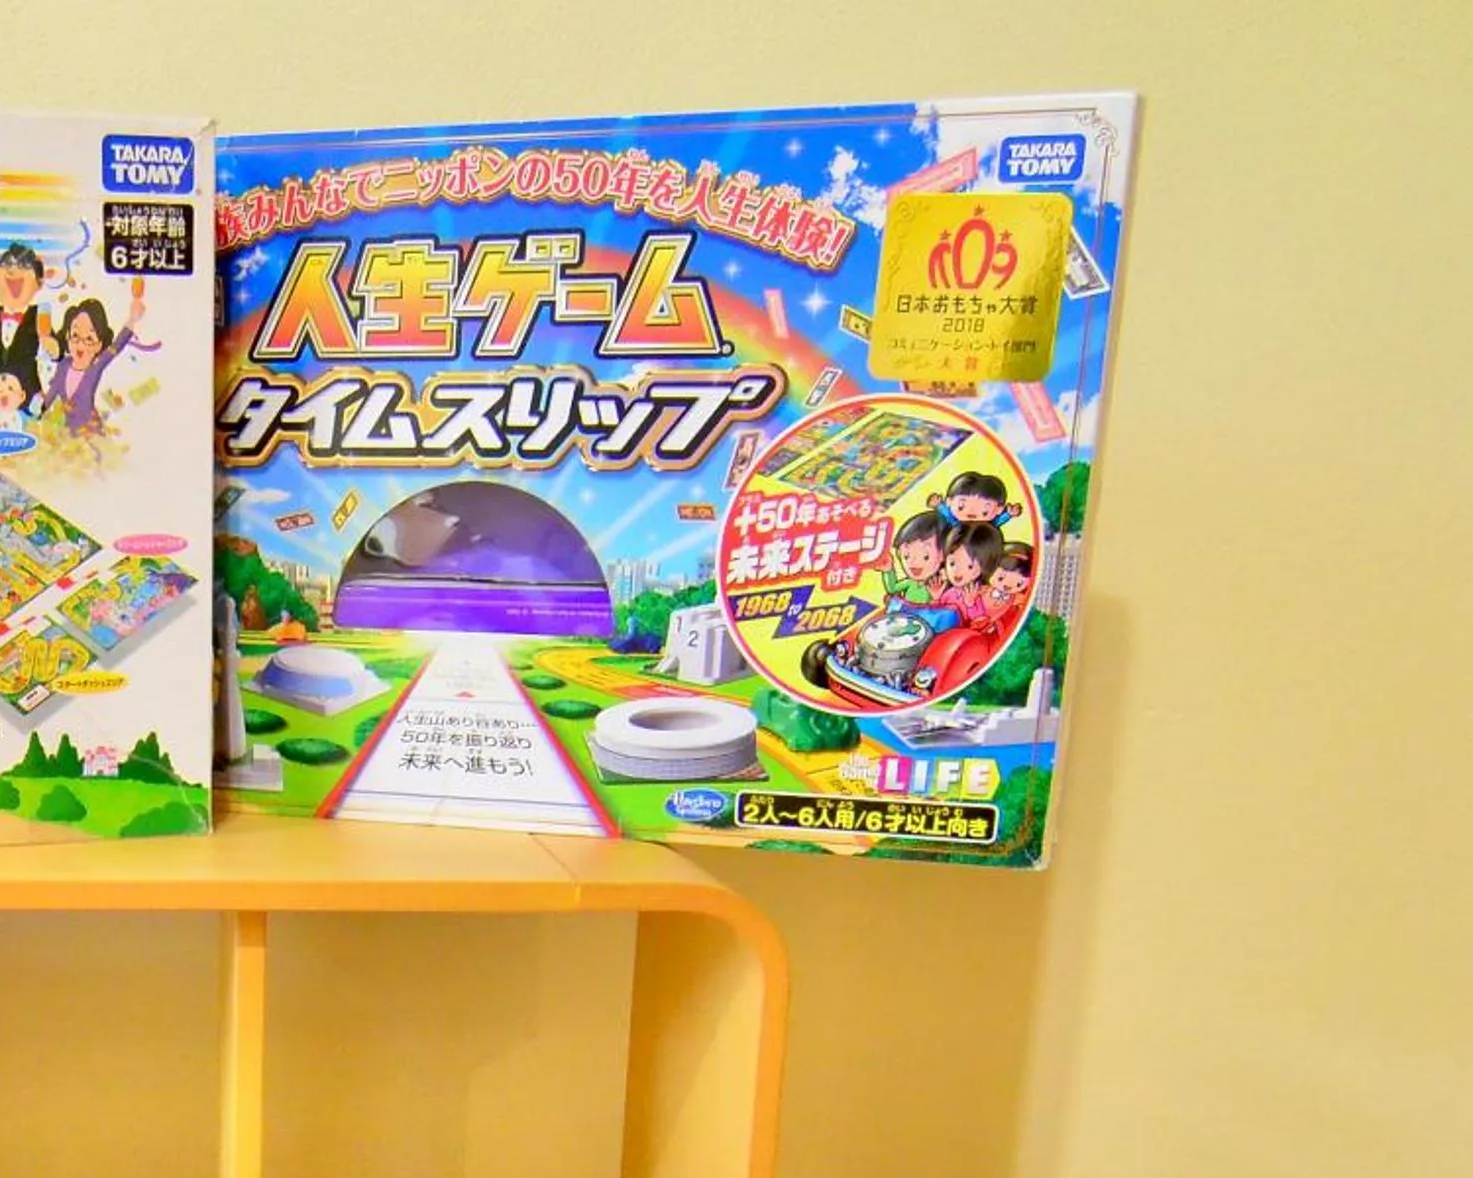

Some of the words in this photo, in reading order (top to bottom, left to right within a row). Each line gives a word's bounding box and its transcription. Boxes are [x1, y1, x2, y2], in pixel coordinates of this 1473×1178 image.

[110, 143, 185, 164] TAKARA
[1008, 141, 1077, 157] TAKARA
[110, 163, 186, 186] TOMY
[1006, 157, 1077, 177] TOMY
[108, 215, 187, 238] 対象年齢
[110, 246, 187, 270] 6才以上
[253, 232, 727, 360] 人生ゲーム
[895, 293, 1038, 316] 日本おもちゃ大賞
[941, 317, 985, 334] 2018
[217, 374, 779, 458] タイムスリップ
[726, 520, 890, 586] 未来ステージ
[734, 592, 792, 618] 1968
[793, 604, 858, 632] 2068
[687, 629, 699, 648] 2
[883, 756, 995, 795] LIFE
